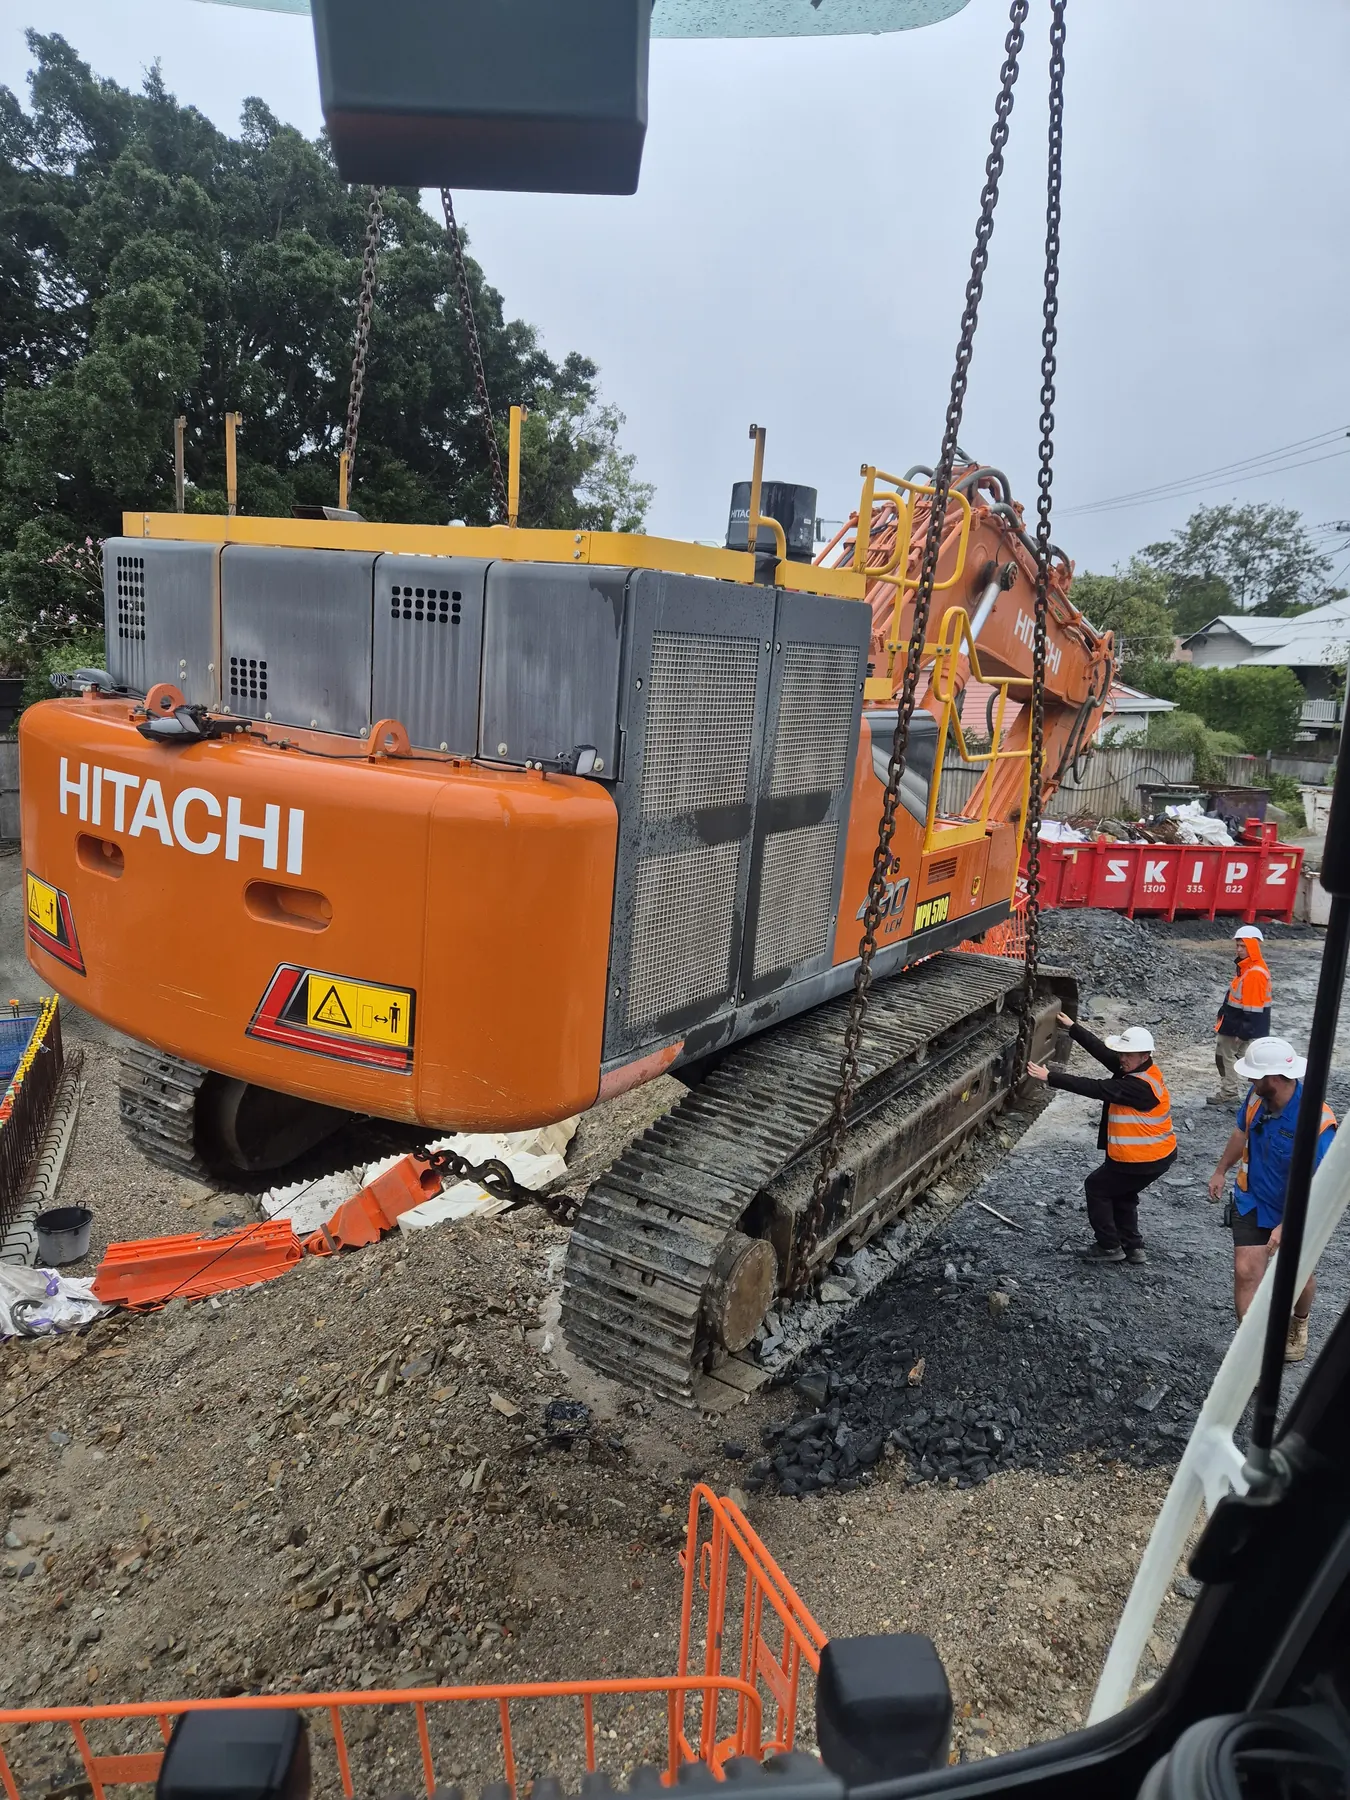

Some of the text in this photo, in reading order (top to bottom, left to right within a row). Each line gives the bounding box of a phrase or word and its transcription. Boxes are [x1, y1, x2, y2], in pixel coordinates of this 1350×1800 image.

[60, 757, 304, 875] HITACHI
[1105, 859, 1288, 884] SKIPZ
[1143, 884, 1243, 893] 1300 335 822
[931, 896, 949, 924] 5709
[884, 918, 902, 934] LCH
